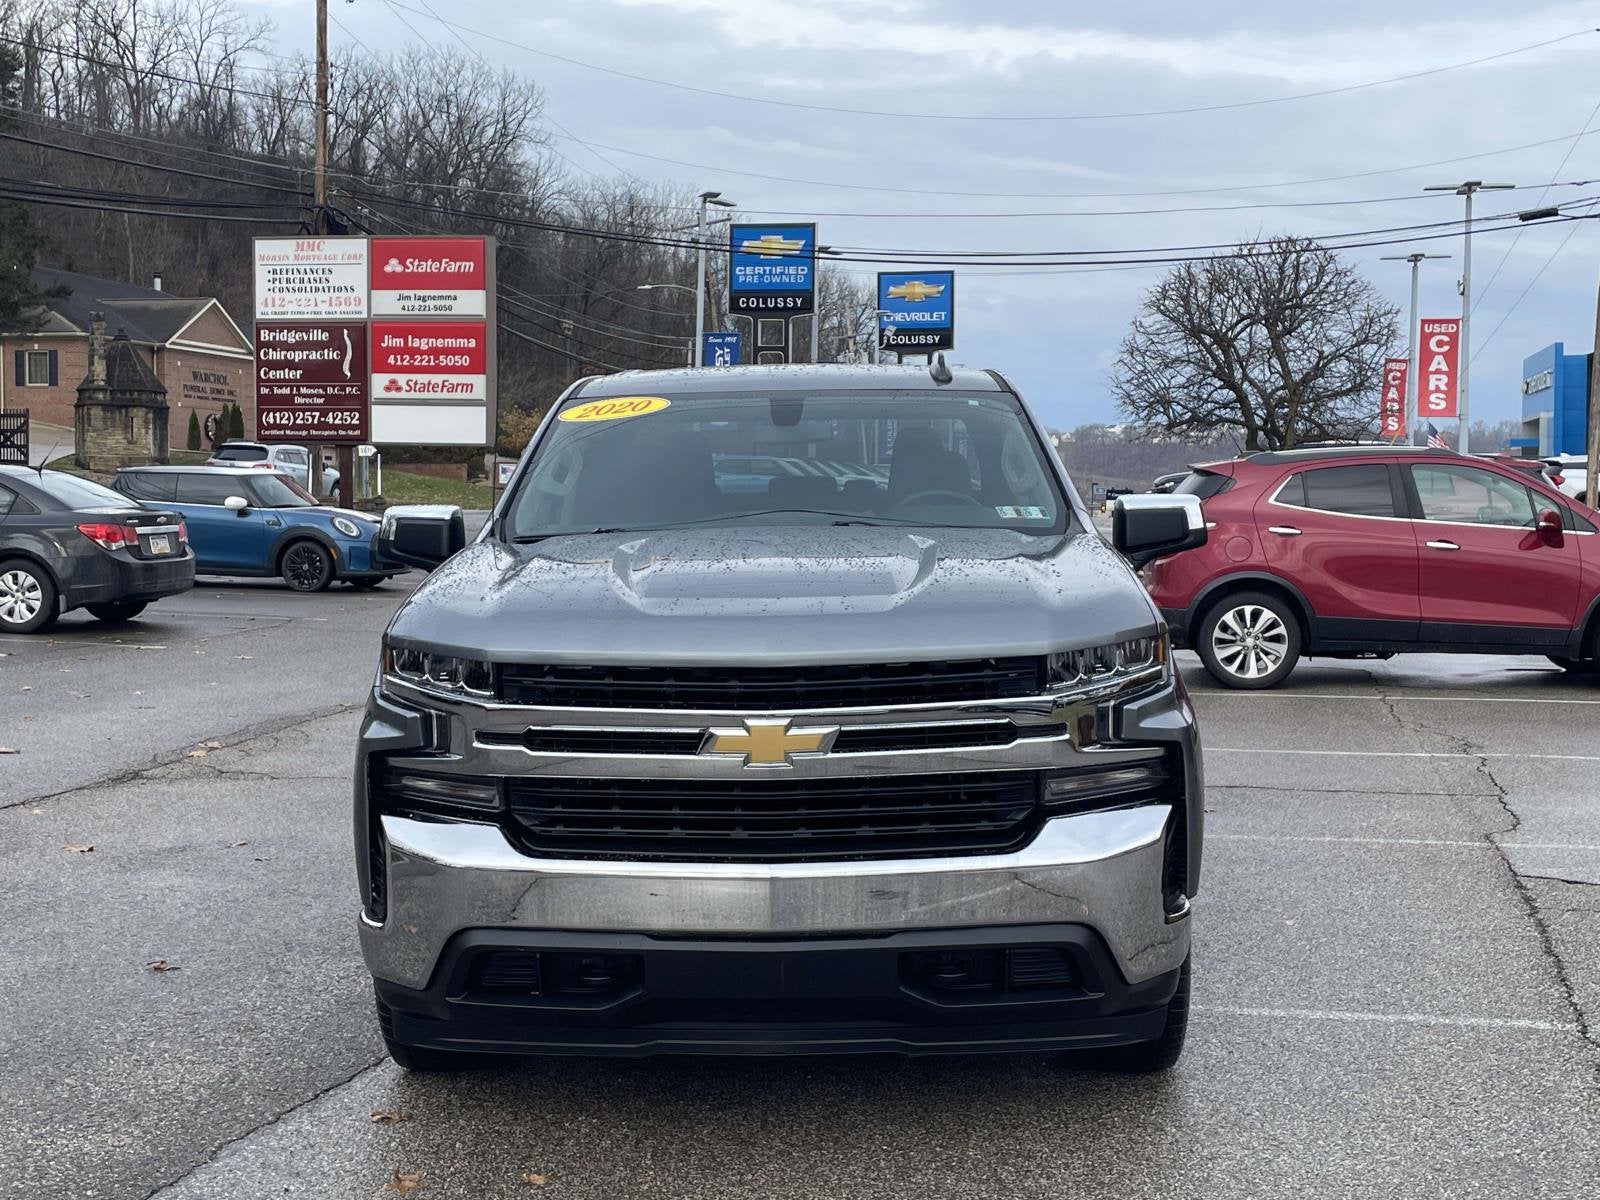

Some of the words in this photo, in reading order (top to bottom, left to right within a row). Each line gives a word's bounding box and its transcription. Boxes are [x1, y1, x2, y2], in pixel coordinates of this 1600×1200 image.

[294, 240, 325, 252] MMC
[272, 268, 333, 276] REFINANCES
[736, 266, 808, 275] CERTIFIED
[738, 275, 804, 283] PRE-OWNED
[272, 285, 355, 294] CONSOLIDATIONS
[261, 296, 362, 308] 412-221-1569
[414, 293, 458, 303] Iagnemma
[739, 298, 802, 308] COLUSSY
[1424, 323, 1457, 333] USED
[260, 329, 330, 344] Bridgeville
[380, 335, 404, 348] Jim
[408, 335, 476, 350] Iagnemma
[890, 335, 940, 344] COLUSSY
[260, 348, 341, 362] Chiropractic
[387, 354, 470, 366] 412-221-5050
[260, 367, 303, 380] Center
[1428, 334, 1450, 410] CARS
[1386, 370, 1402, 431] CARS
[576, 400, 652, 418] 2020
